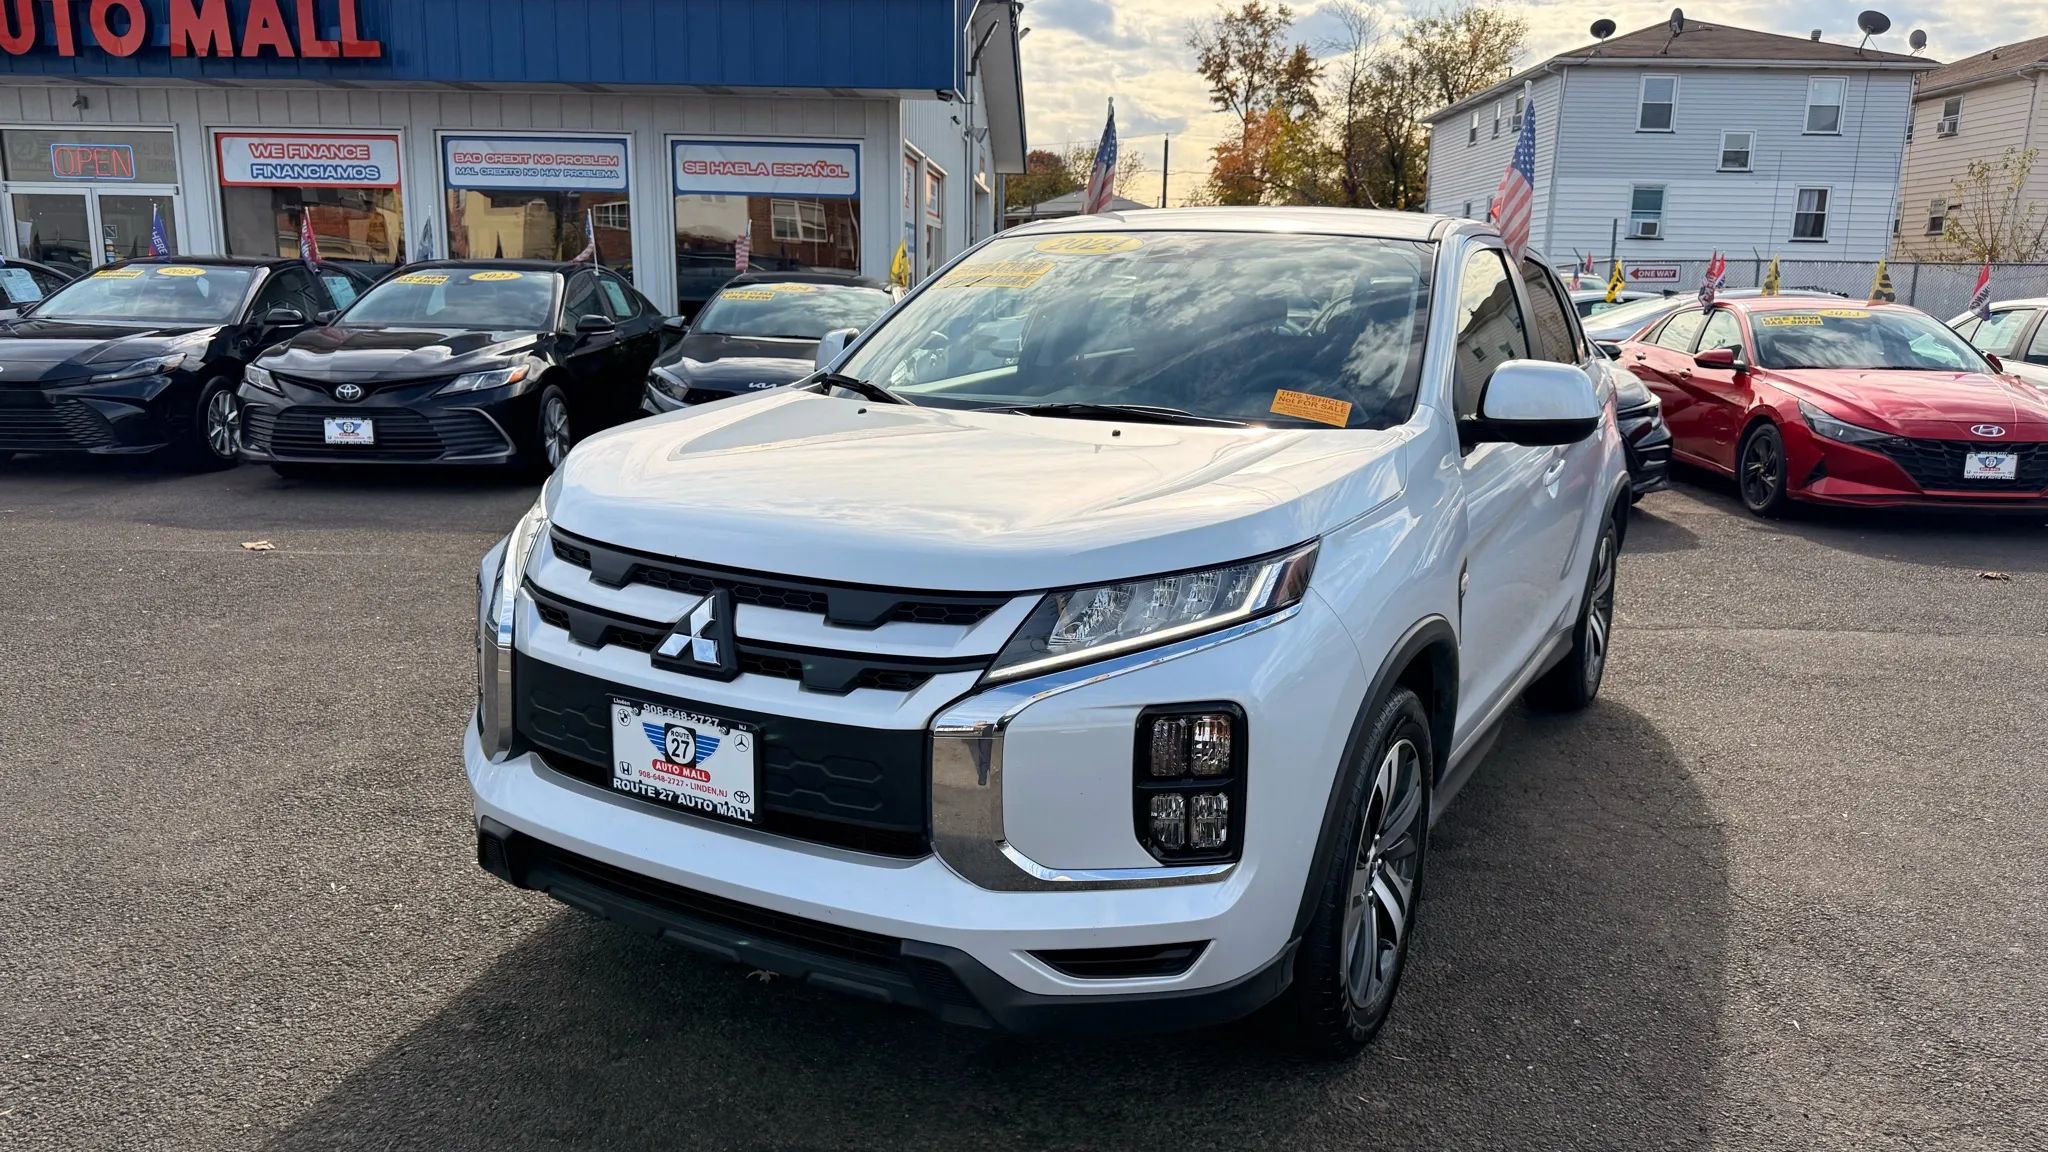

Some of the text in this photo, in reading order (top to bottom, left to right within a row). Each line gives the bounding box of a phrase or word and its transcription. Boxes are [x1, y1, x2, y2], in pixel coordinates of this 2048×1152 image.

[170, 0, 381, 58] MALL
[250, 143, 369, 160] WE FINANCE
[454, 152, 619, 167] BAD CREDIT NO PROBLEM
[54, 146, 132, 177] OPEN
[683, 160, 849, 178] SE HABLA ESPAÑOL
[251, 164, 380, 180] FINANCIAMOS
[455, 167, 619, 178] MAL CREDITO NO HAY PROBLEMA
[152, 231, 168, 256] HERE
[1046, 238, 1131, 250] 2024
[1638, 270, 1675, 278] ONE WAY
[1281, 391, 1348, 407] THIS VEHICLE
[1297, 400, 1318, 409] FOR
[1320, 404, 1348, 414] SALE
[613, 697, 631, 706] Linden
[643, 703, 719, 727] 908-648-2727
[670, 730, 690, 740] ROUTE
[671, 738, 690, 759] 27
[638, 769, 684, 787] 908-648-2727
[655, 760, 708, 781] AUTO MALL
[613, 777, 752, 822] ROUTE 27 AUTO MALL
